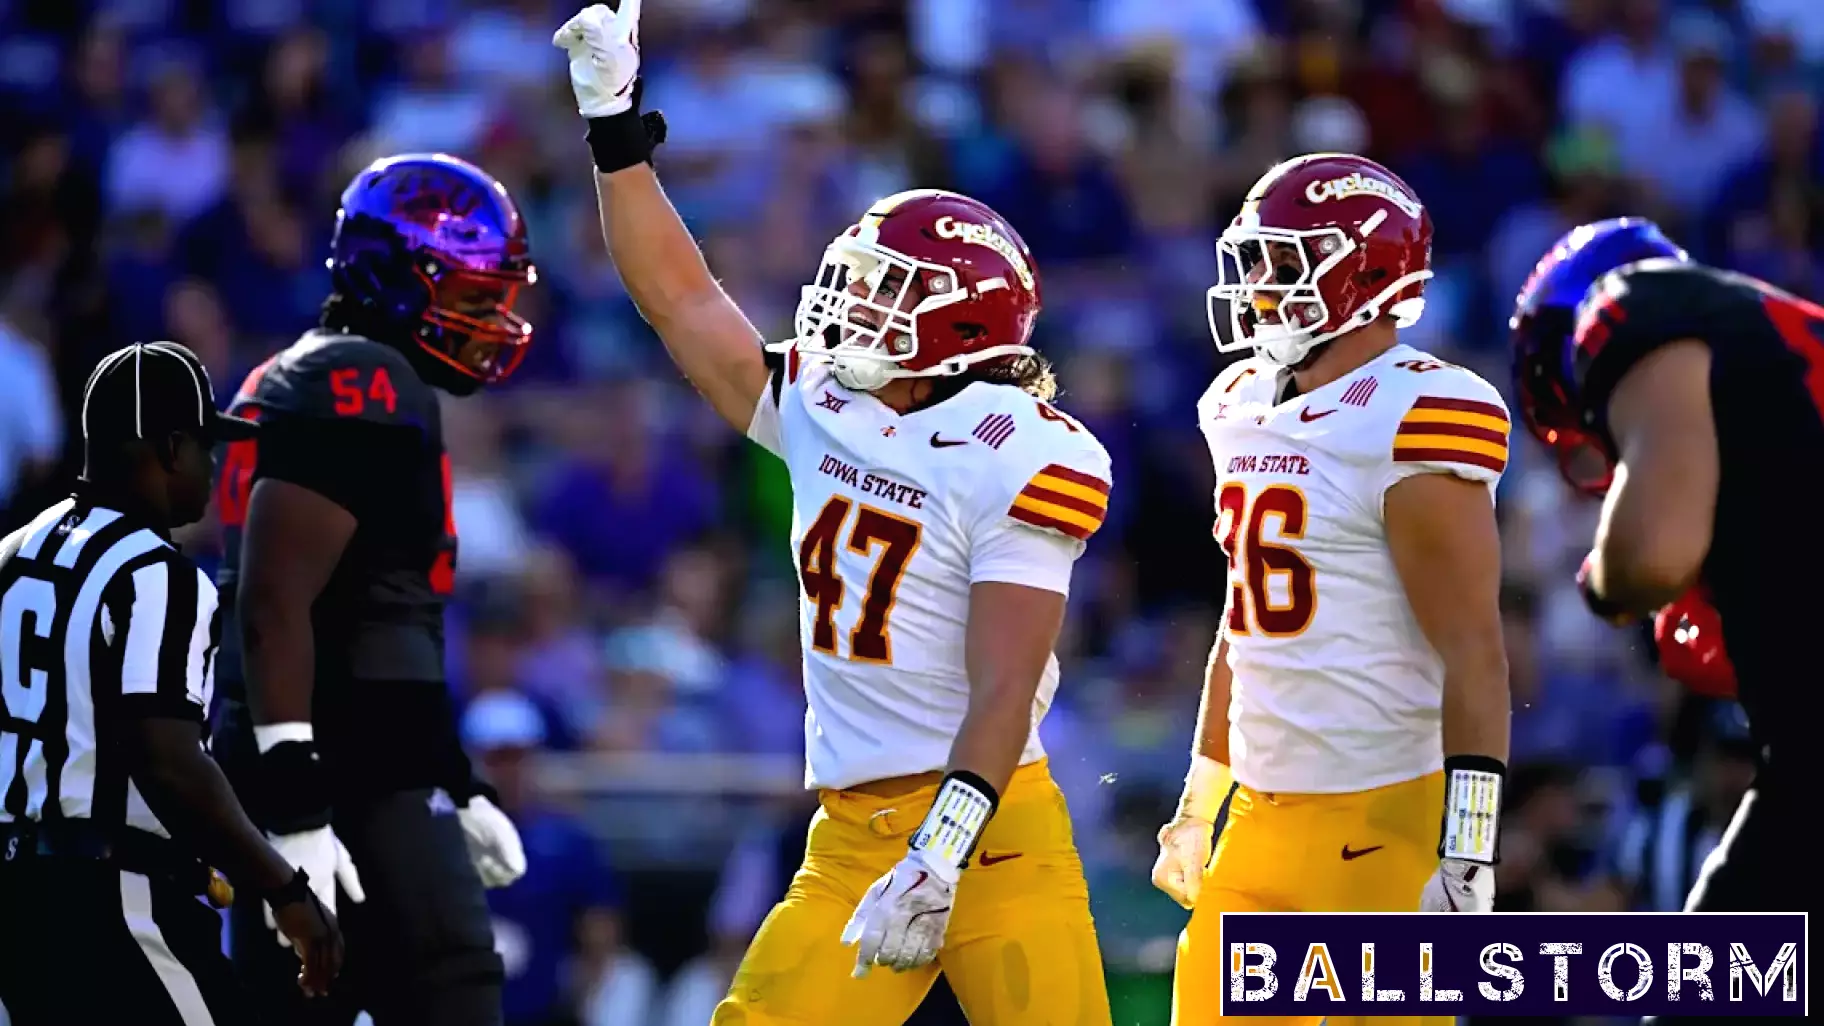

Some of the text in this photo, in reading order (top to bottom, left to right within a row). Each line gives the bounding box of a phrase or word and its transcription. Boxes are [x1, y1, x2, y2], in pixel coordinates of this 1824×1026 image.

[329, 366, 397, 416] 54
[818, 454, 928, 510] IOWA STATE
[1258, 455, 1310, 475] STATE
[799, 494, 923, 666] 47
[0, 576, 56, 723] C
